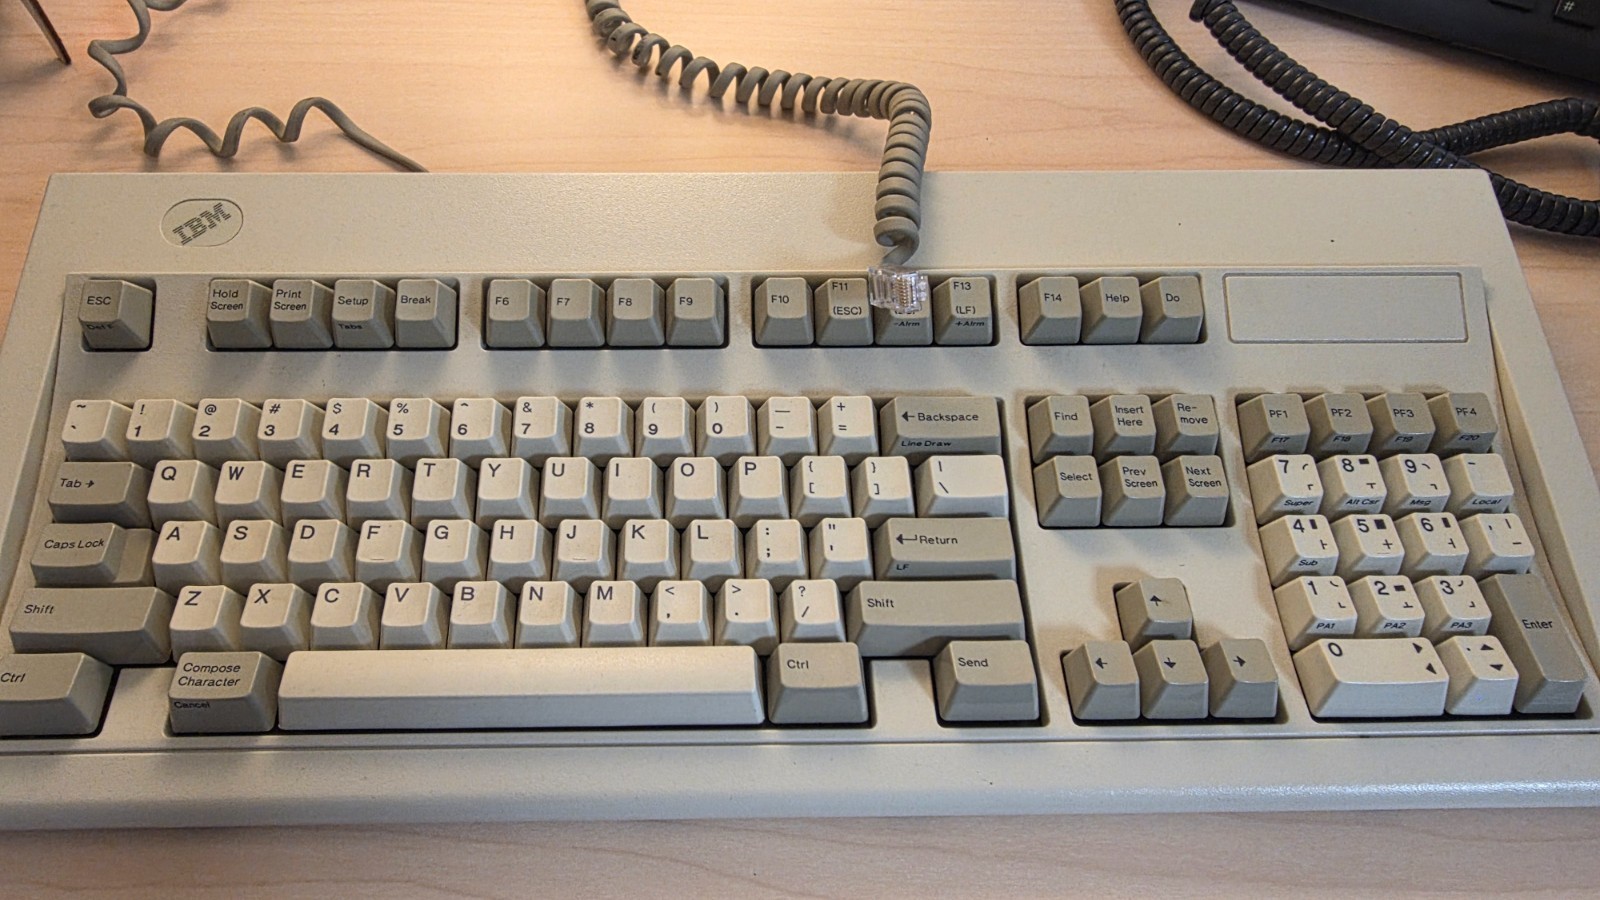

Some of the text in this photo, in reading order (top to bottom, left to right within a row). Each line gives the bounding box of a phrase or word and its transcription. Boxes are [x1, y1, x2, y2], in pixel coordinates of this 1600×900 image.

[1563, 1, 1575, 12] #
[172, 202, 231, 246] IBM
[832, 282, 847, 290] F11
[953, 281, 971, 290] F13
[213, 289, 239, 298] Hold
[276, 289, 301, 298] Print
[771, 295, 789, 303] F10
[1044, 293, 1062, 301] F14
[1105, 294, 1129, 303] Help
[1166, 293, 1180, 302] Do
[87, 296, 111, 305] ESC
[338, 296, 368, 306] Setup
[401, 295, 431, 304] Break
[496, 297, 509, 305] F6
[557, 298, 570, 306] F7
[619, 298, 632, 306] F8
[680, 297, 693, 305] F9
[210, 301, 243, 310] Screen
[274, 301, 306, 310] Screen
[833, 306, 862, 315] (ESC)
[956, 306, 975, 314] (LF)
[140, 404, 145, 414] !
[205, 404, 217, 415] @
[269, 404, 281, 414] #
[333, 403, 342, 414] $
[397, 403, 408, 413] %
[523, 402, 532, 412] &
[652, 403, 655, 413] (
[715, 402, 718, 413] )
[837, 403, 845, 411] +
[1115, 405, 1144, 414] Insert
[1177, 403, 1197, 412] Re-
[1331, 408, 1352, 417] PF2
[1456, 407, 1477, 416] PF4
[918, 413, 978, 422] Backspace
[1054, 412, 1078, 420] Find
[1269, 410, 1288, 418] PF1
[1393, 409, 1414, 417] PF3
[1117, 418, 1142, 426] Here
[135, 426, 141, 437] 1
[199, 425, 210, 437] 2
[264, 425, 275, 436] 3
[329, 424, 338, 435] 4
[393, 424, 403, 435] 5
[458, 424, 467, 435] 6
[522, 423, 531, 434] 7
[585, 423, 594, 434] 8
[648, 424, 658, 435] 9
[712, 423, 723, 434] 0
[357, 464, 370, 477] R
[424, 463, 436, 477] T
[488, 463, 501, 477] Y
[552, 463, 565, 477] U
[616, 463, 619, 477] I
[681, 463, 694, 477] O
[745, 462, 756, 475] P
[1278, 459, 1289, 473] 7
[1342, 458, 1354, 472] 8
[1405, 459, 1417, 473] 9
[161, 466, 176, 480] Q
[229, 466, 244, 480] W
[292, 464, 305, 478] E
[1060, 472, 1092, 481] Select
[1122, 467, 1146, 476] Prev
[1186, 467, 1211, 475] Next
[61, 478, 81, 488] Tab
[1125, 479, 1158, 487] Screen
[1189, 479, 1221, 487] Screen
[1293, 519, 1304, 533] 4
[1357, 519, 1369, 533] 5
[1421, 518, 1434, 532] 6
[166, 527, 180, 540] A
[234, 526, 248, 540] S
[300, 525, 315, 539] D
[367, 525, 380, 539] F
[434, 525, 448, 539] G
[500, 525, 514, 539] H
[566, 525, 576, 539] J
[632, 525, 645, 539] K
[698, 525, 708, 539] L
[44, 539, 104, 549] Caps Lock
[919, 536, 958, 544] Return
[665, 587, 674, 595] <
[732, 585, 741, 593] >
[799, 586, 805, 597] ?
[1308, 581, 1317, 595] 1
[1374, 581, 1389, 595] 2
[1440, 580, 1454, 594] 3
[184, 591, 201, 606] Z
[254, 589, 271, 604] X
[325, 588, 339, 603] C
[395, 587, 409, 602] V
[461, 587, 474, 601] B
[529, 586, 543, 601] N
[597, 586, 613, 600] M
[867, 598, 894, 608] Shift
[24, 605, 54, 614] Shift
[1522, 619, 1552, 629] Enter
[1328, 642, 1343, 657] 0
[787, 659, 808, 669] Ctrl
[958, 657, 988, 667] Send
[183, 663, 240, 674] Compose
[1, 673, 25, 682] Ctrl
[178, 676, 240, 686] Character
